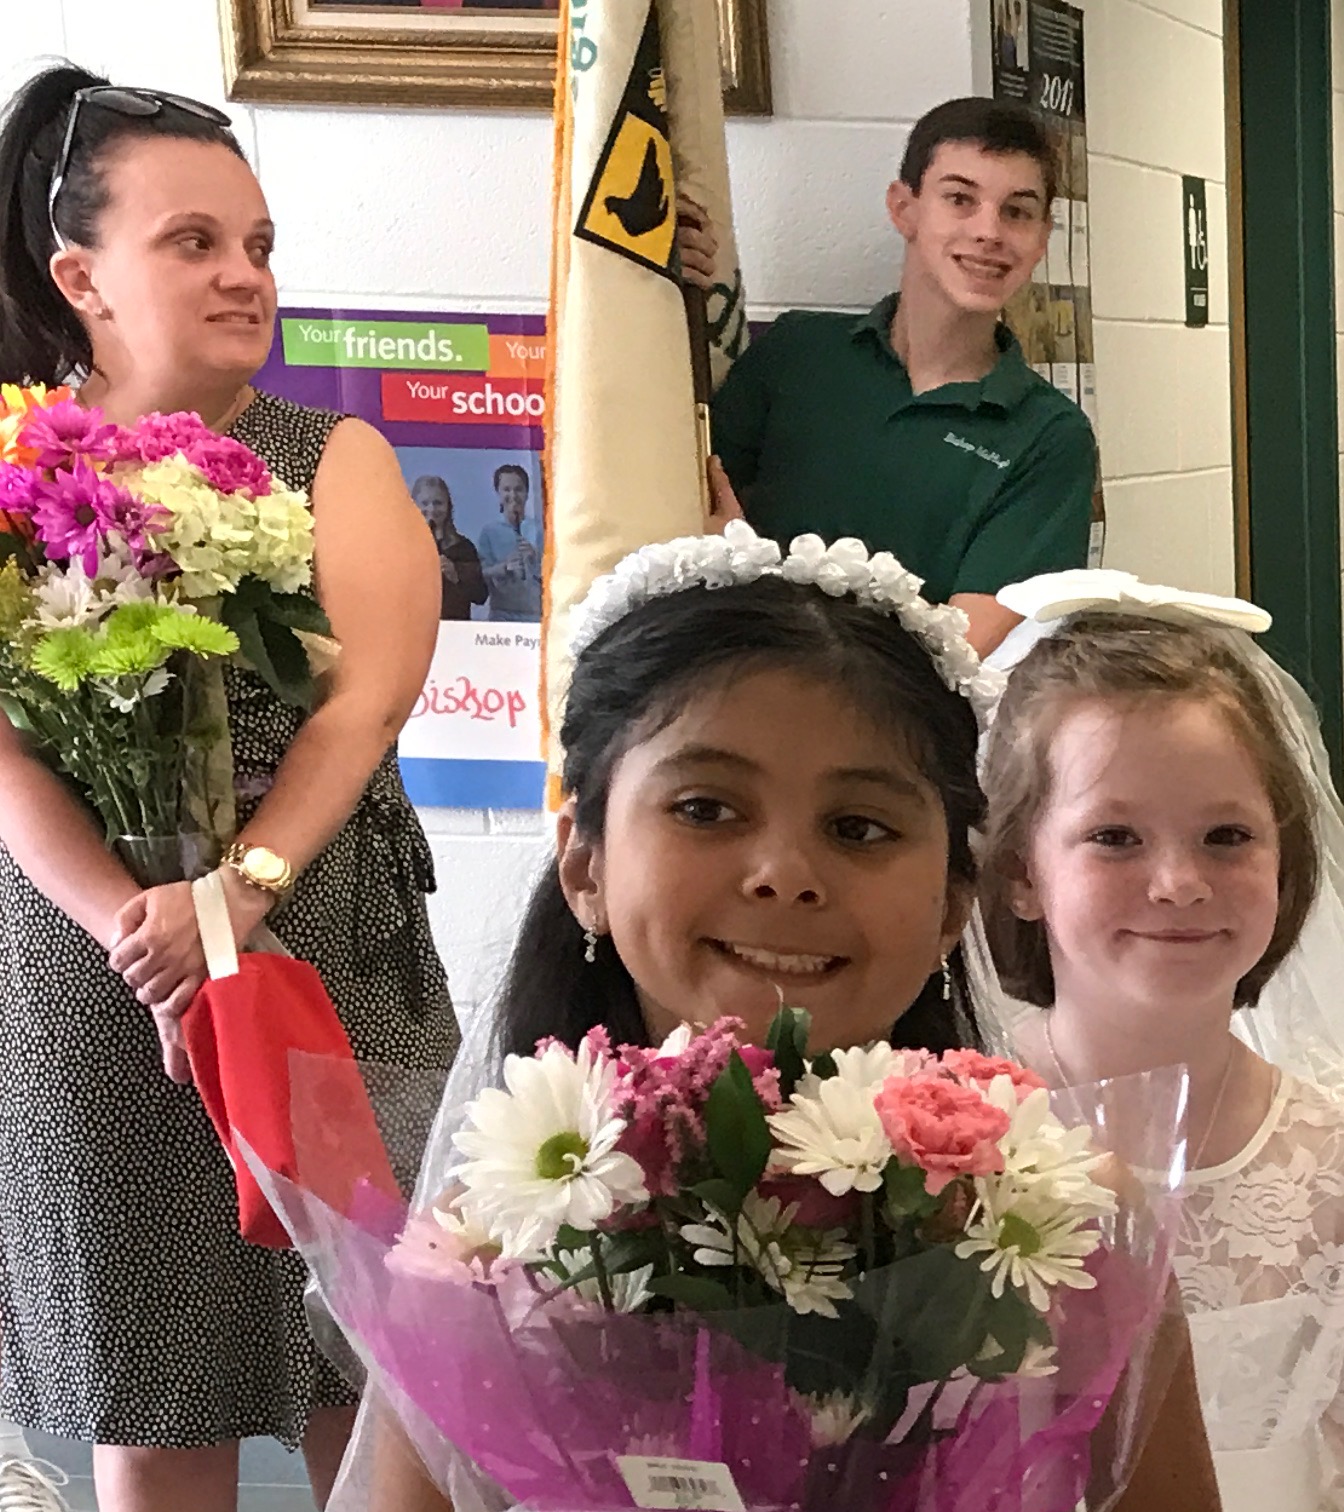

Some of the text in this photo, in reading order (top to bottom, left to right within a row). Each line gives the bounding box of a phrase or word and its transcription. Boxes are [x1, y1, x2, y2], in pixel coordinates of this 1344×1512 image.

[299, 324, 463, 362] Your friends.
[505, 341, 546, 360] Your
[406, 381, 449, 400] Your
[475, 633, 541, 650] Make Pay
